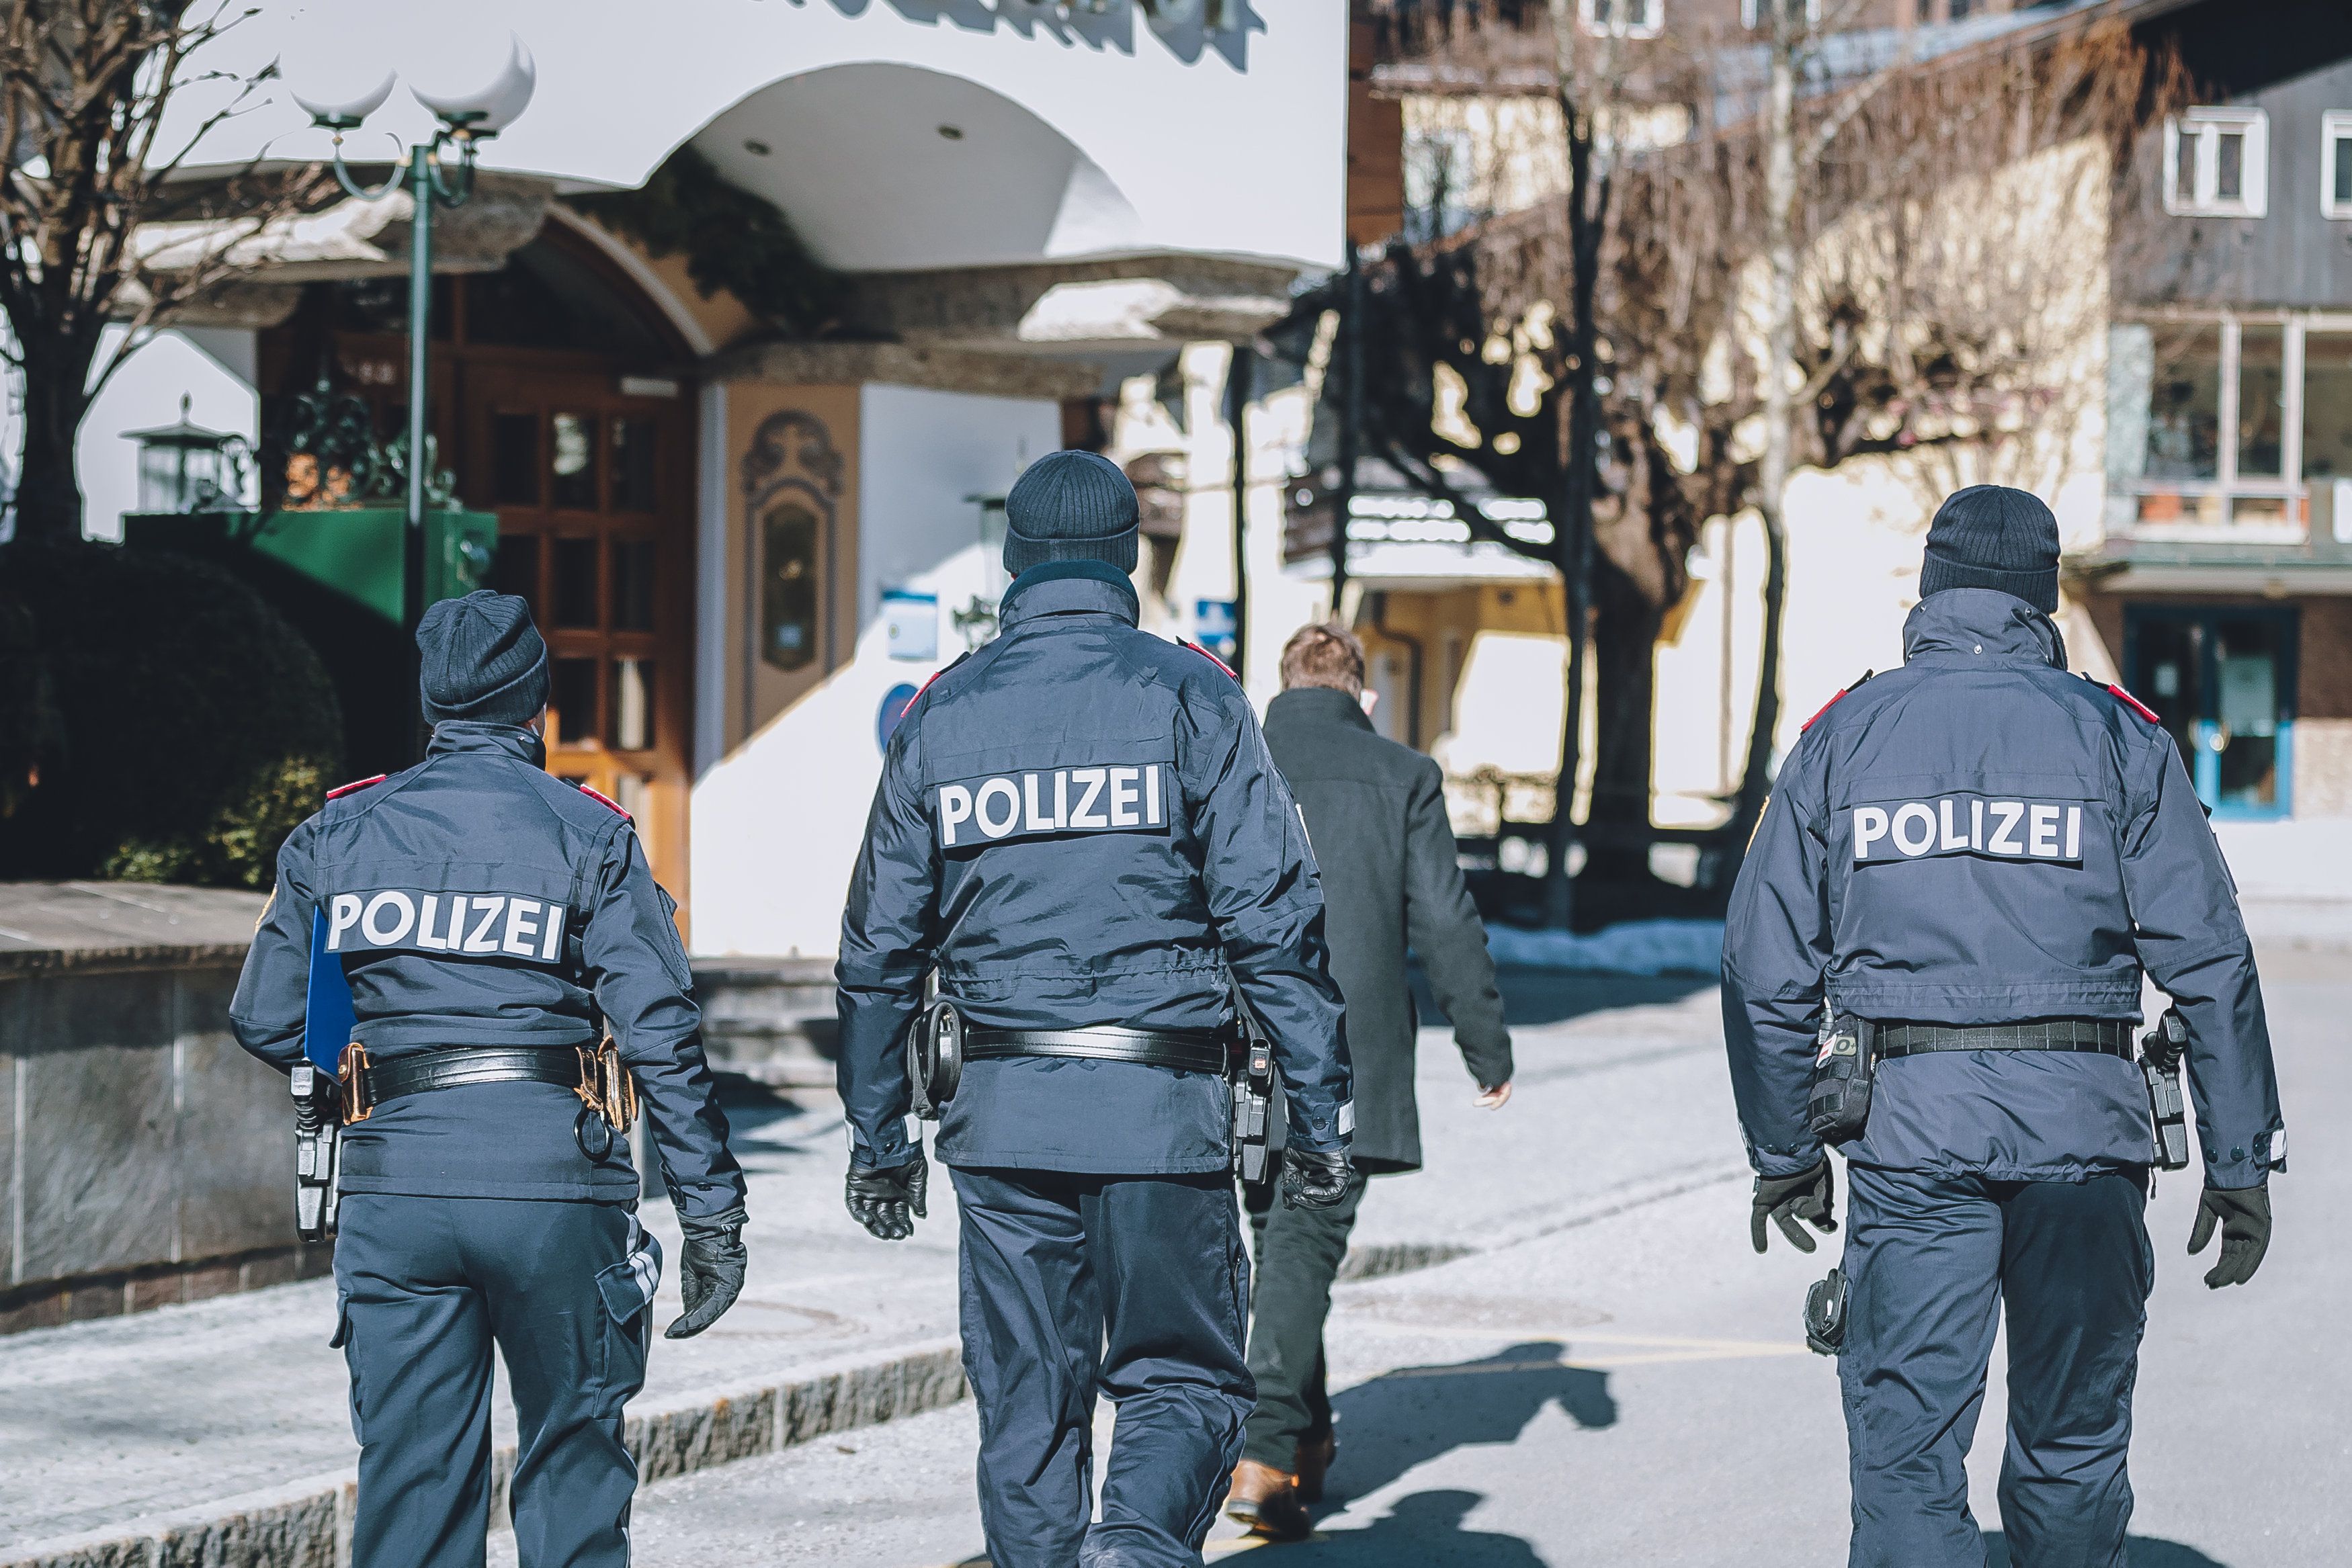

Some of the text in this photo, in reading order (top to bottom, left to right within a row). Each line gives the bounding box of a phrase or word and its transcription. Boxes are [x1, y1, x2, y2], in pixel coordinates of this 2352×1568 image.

[939, 765, 1160, 846] POLIZEI
[1853, 799, 2081, 859] POLIZEI
[327, 890, 563, 960] POLIZEI
